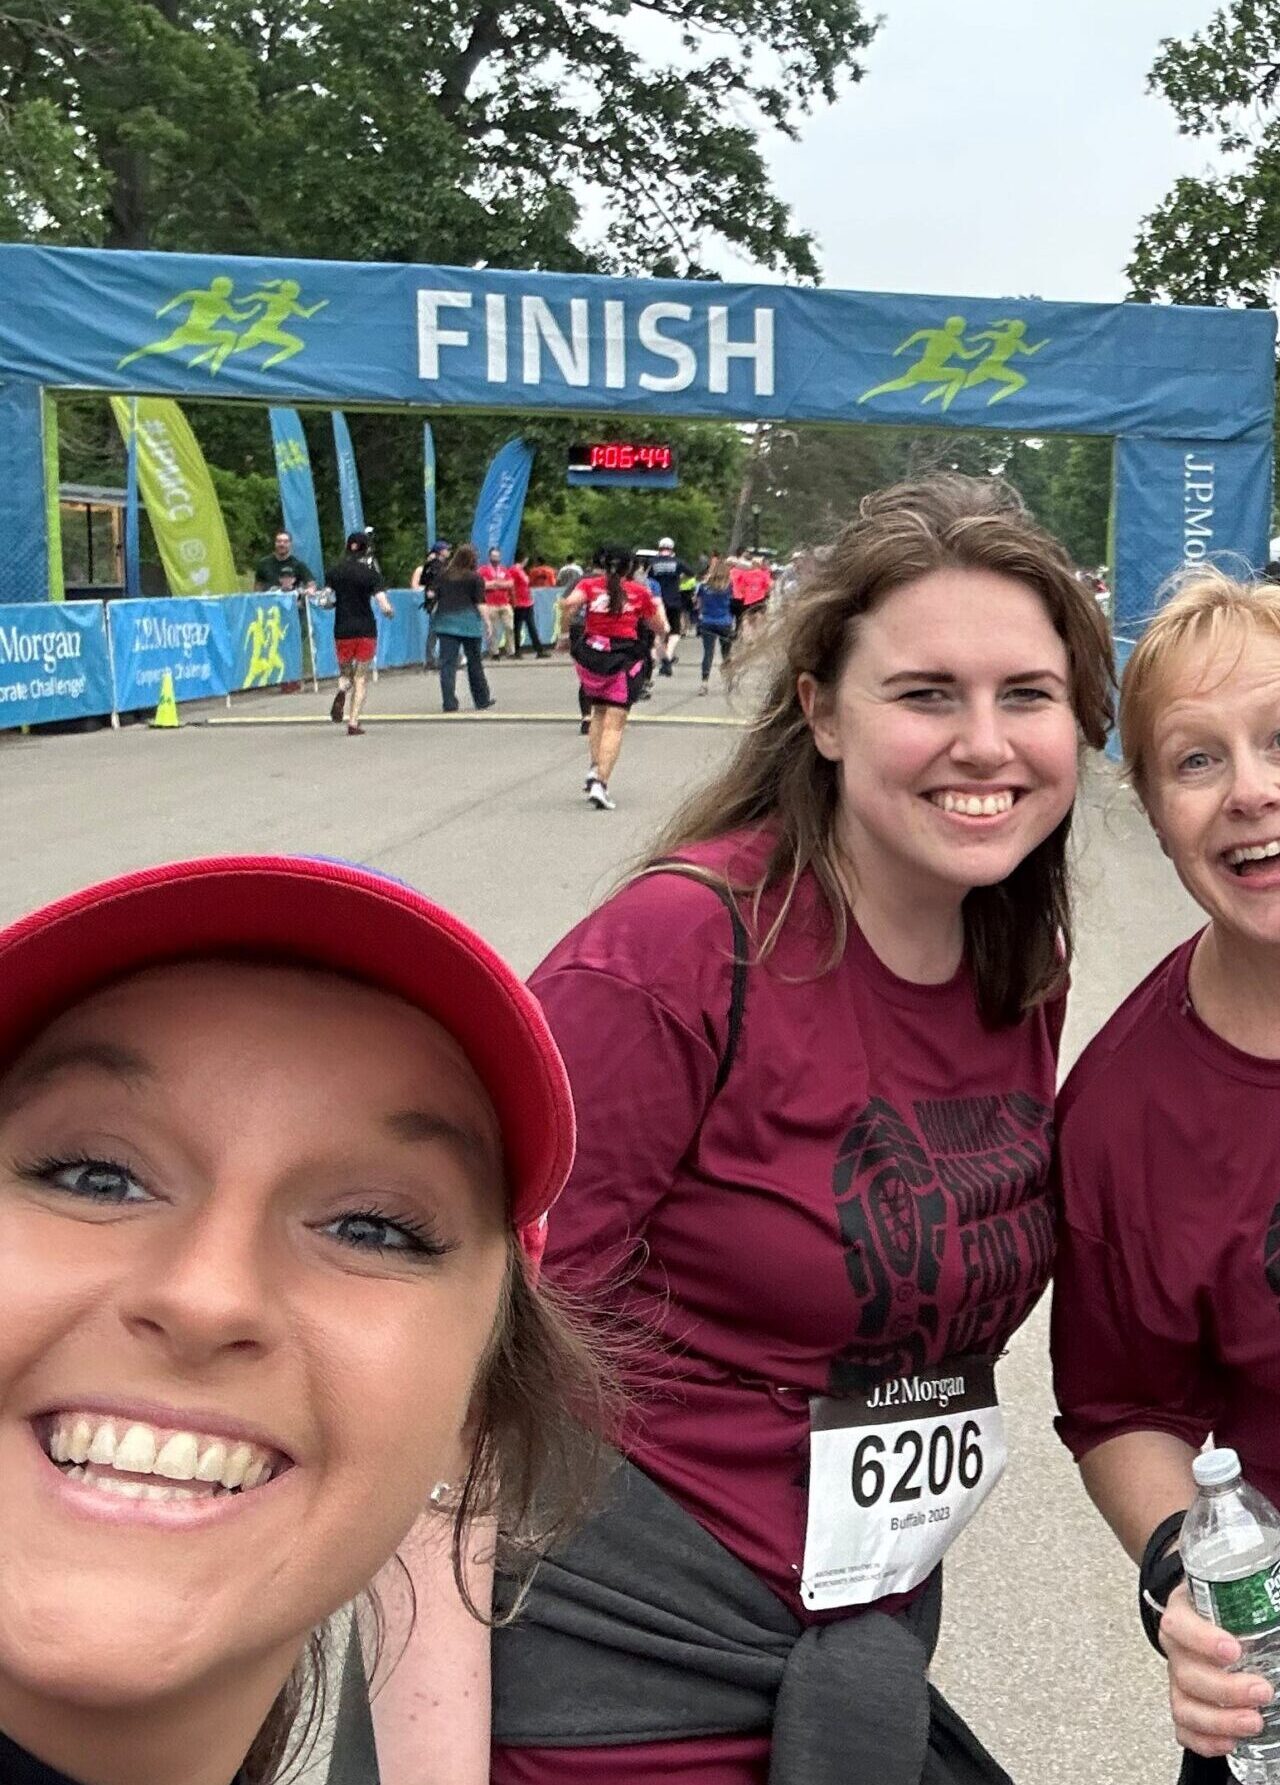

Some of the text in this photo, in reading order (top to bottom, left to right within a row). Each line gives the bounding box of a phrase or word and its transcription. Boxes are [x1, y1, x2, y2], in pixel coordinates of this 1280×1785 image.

[417, 288, 775, 397] FINISH
[0, 625, 81, 674] Morgan
[866, 1375, 966, 1408] J.P.Morgan
[851, 1419, 984, 1508] 6206
[890, 1505, 951, 1531] Buffalo 2023
